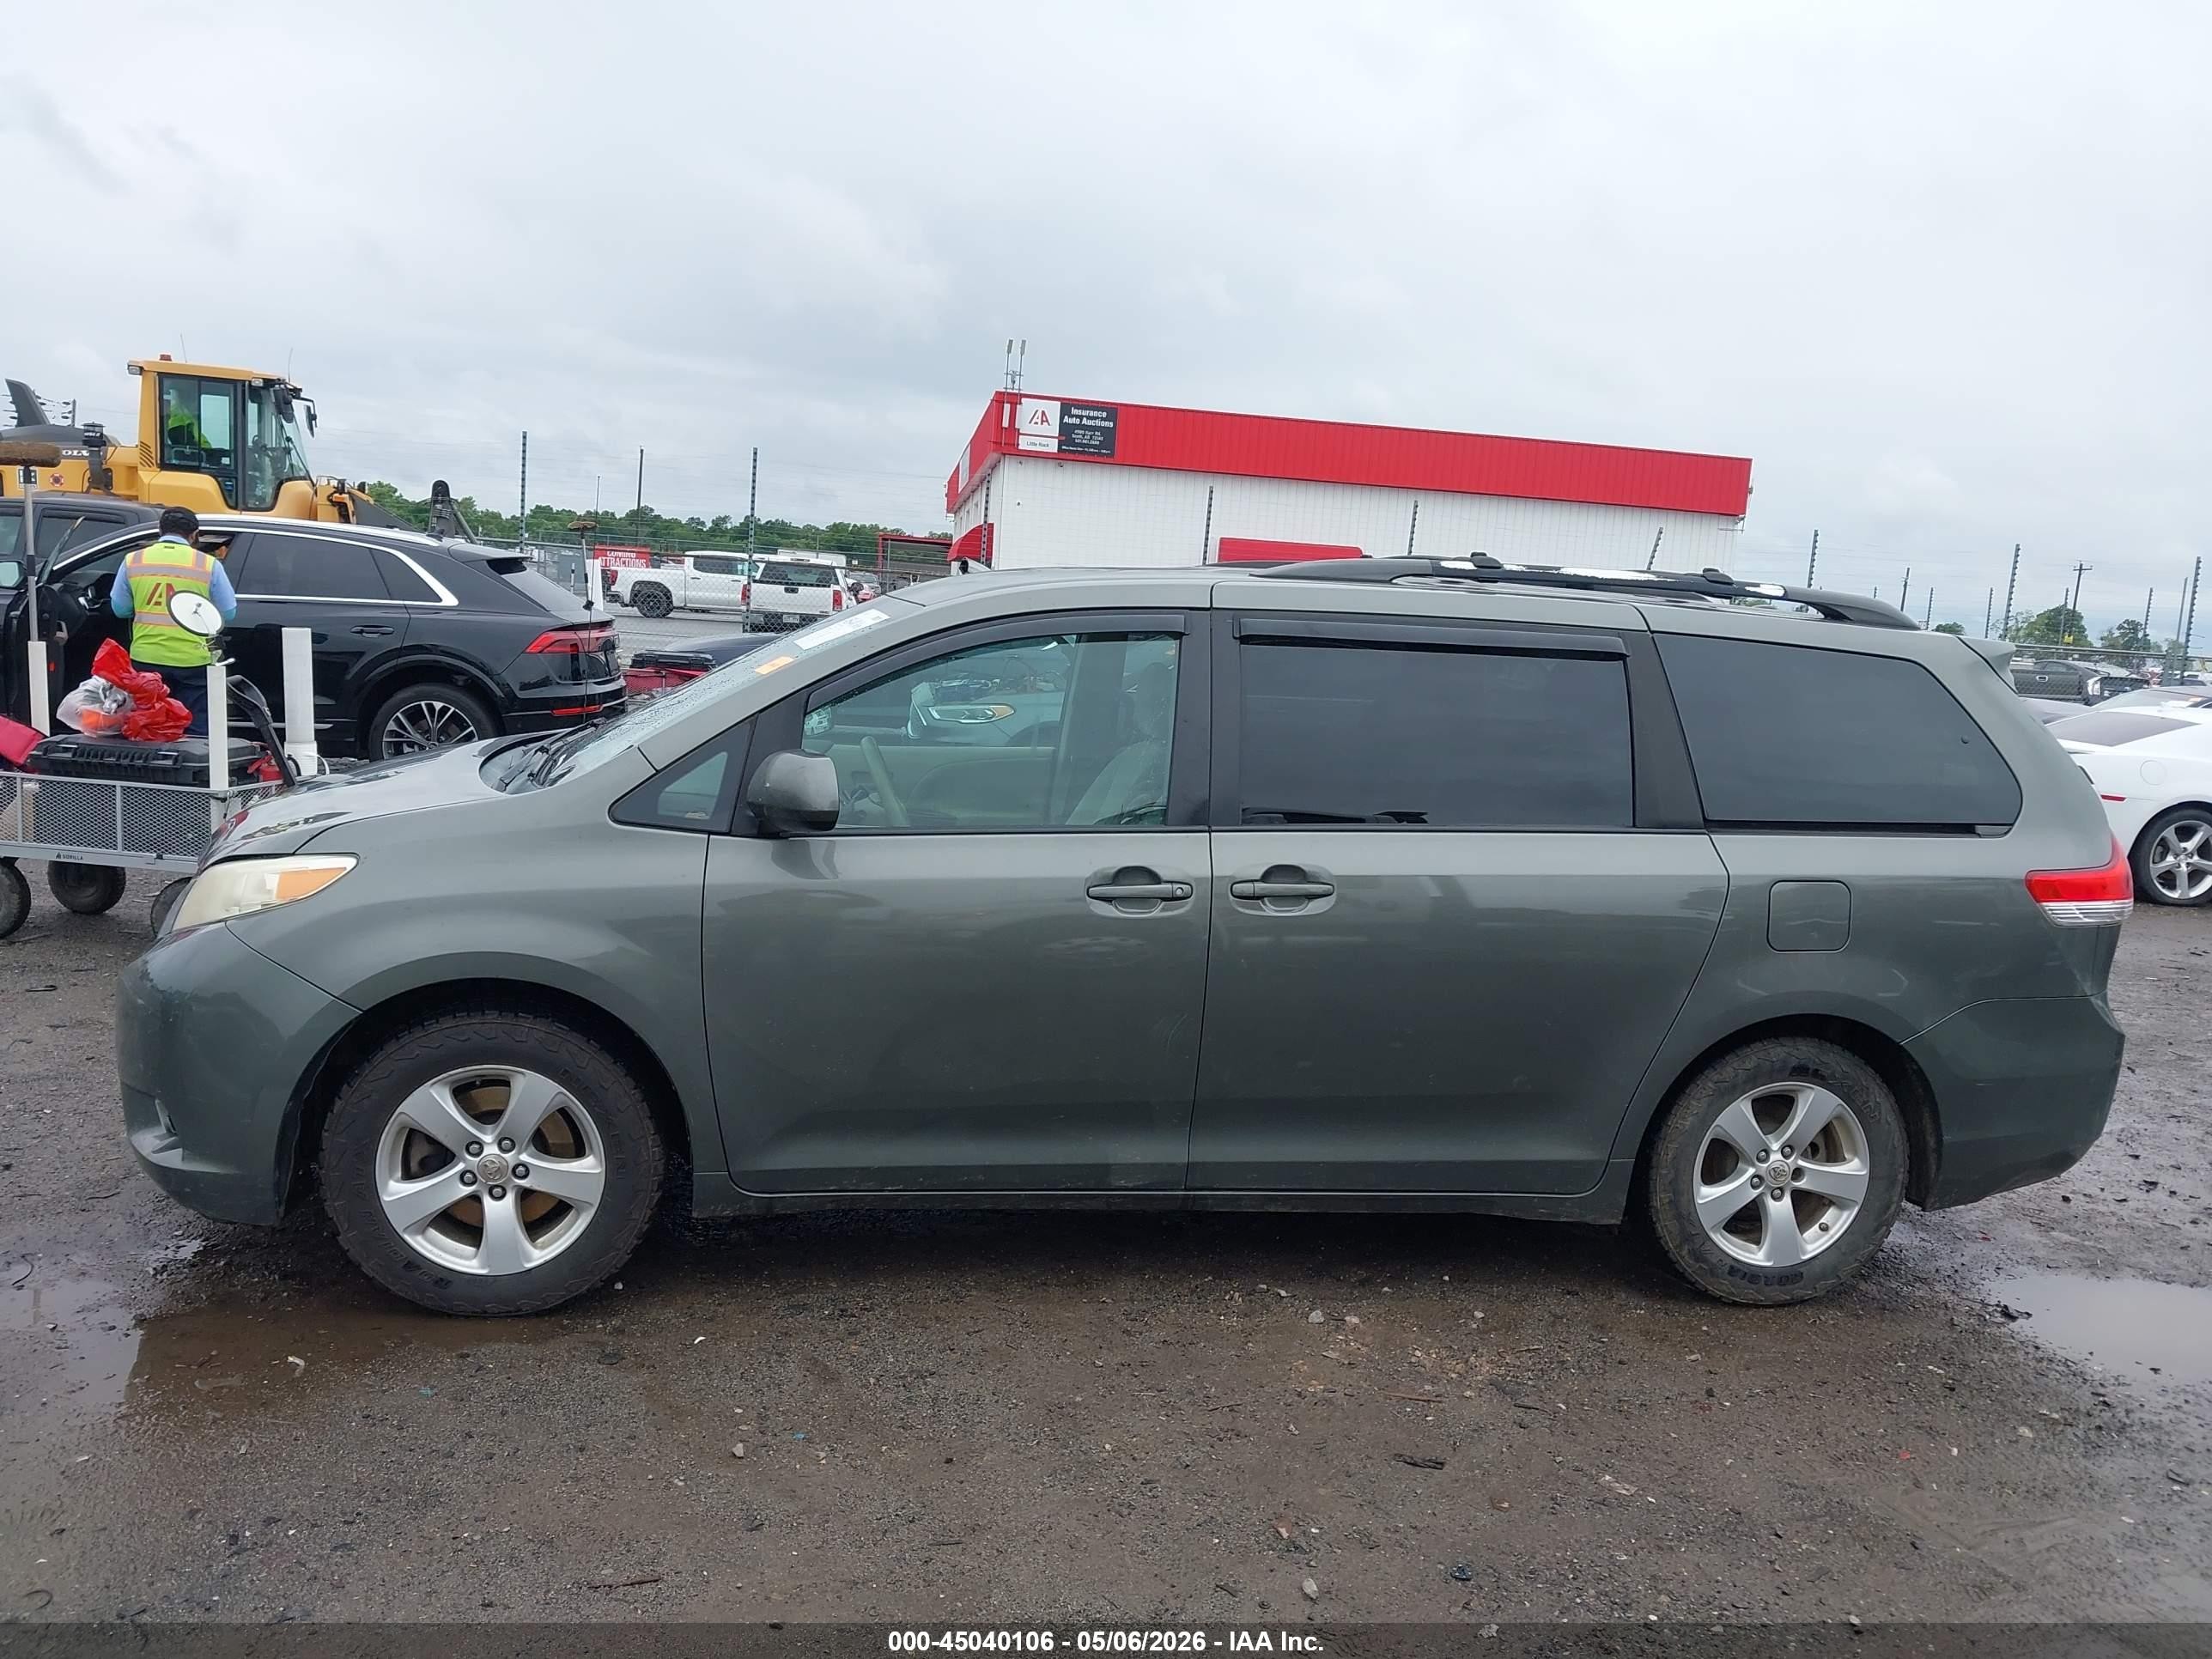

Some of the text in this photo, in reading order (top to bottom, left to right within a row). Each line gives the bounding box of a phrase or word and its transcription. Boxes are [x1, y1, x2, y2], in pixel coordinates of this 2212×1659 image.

[1071, 407, 1107, 417] Insurance
[1063, 416, 1114, 428] Auto Auctions
[599, 557, 647, 568] ATTRACTIONS
